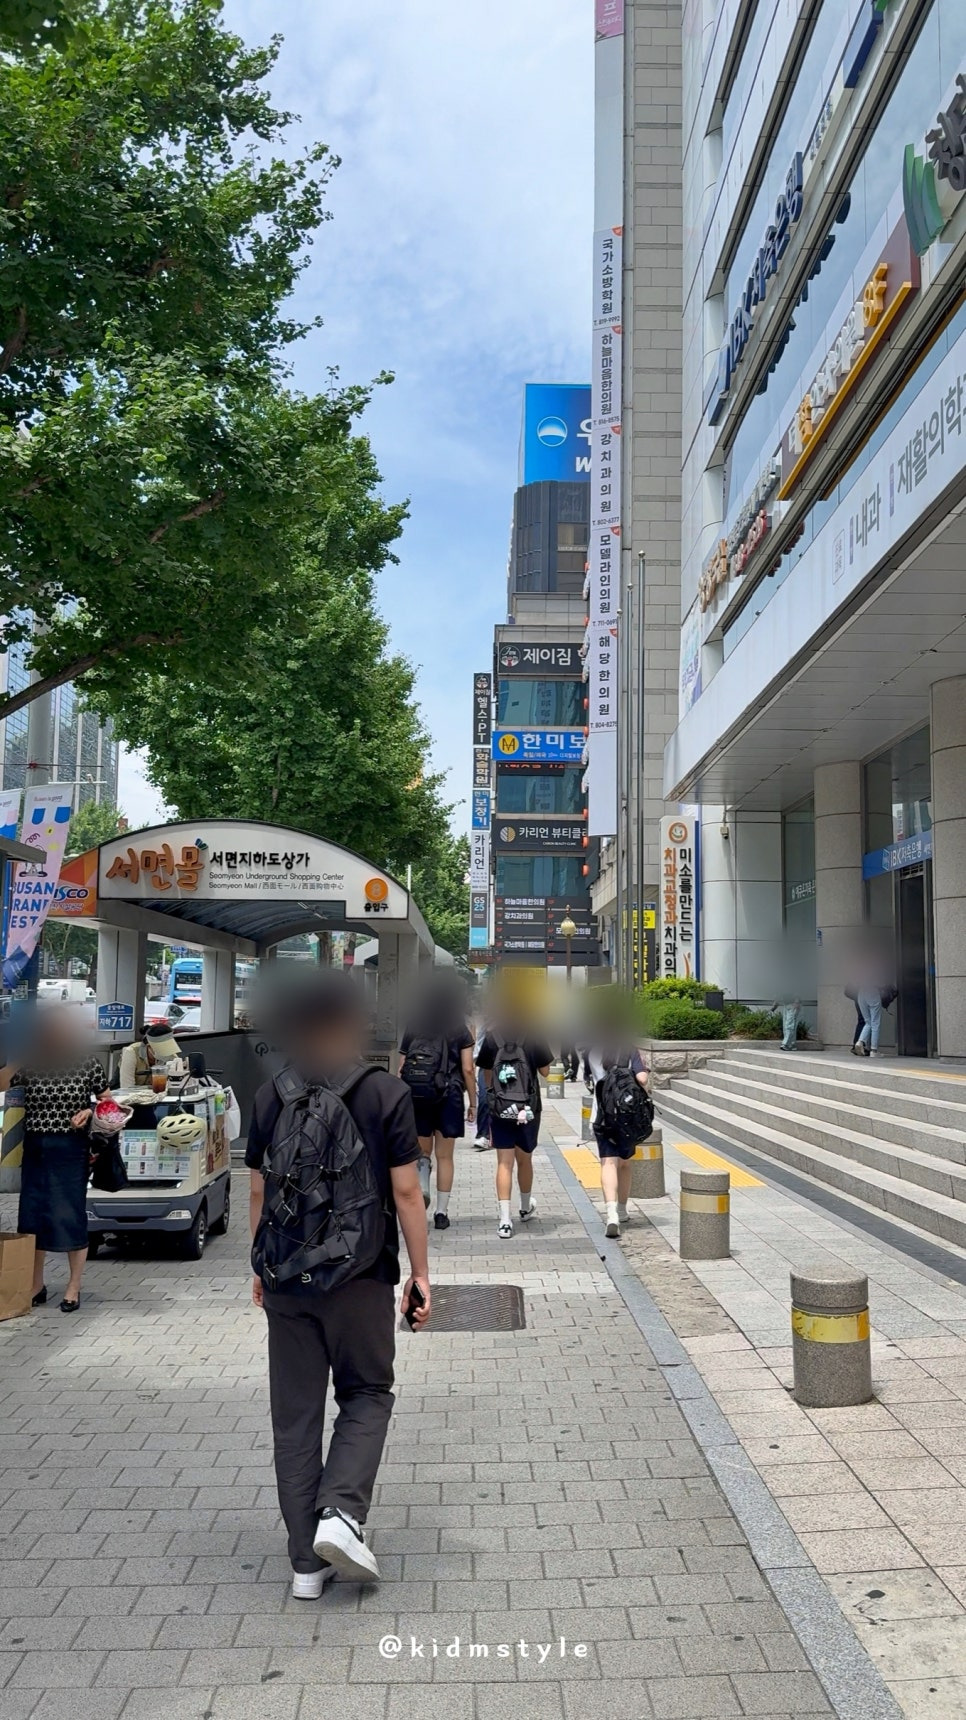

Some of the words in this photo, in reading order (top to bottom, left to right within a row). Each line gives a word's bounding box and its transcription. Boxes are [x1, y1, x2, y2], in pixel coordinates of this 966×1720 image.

[601, 238, 613, 314] 국가소방학원
[729, 151, 803, 373] IBK저축은행
[600, 333, 612, 415] 하늘마음한의원
[600, 433, 612, 513] 강치과의원
[855, 482, 881, 548] 내과
[897, 375, 966, 495] 재활의학
[599, 534, 611, 614] 모델라인의원
[523, 648, 572, 666] 제이짐
[599, 635, 611, 716] 해당한의원
[474, 798, 488, 826] 보청기
[519, 826, 549, 839] 카리언
[210, 851, 311, 870] 서면지하도상가
[474, 834, 486, 870] 카리언
[890, 840, 922, 868] IBK저축은행
[105, 842, 205, 892] 서면몰
[209, 872, 244, 880] Seomyeon
[245, 873, 287, 881] Underground
[289, 873, 321, 881] Shopping
[208, 882, 243, 890] Seomyeon
[473, 896, 485, 904] GS
[679, 847, 693, 942] 미소를만드는
[13, 898, 49, 912] RAN
[364, 902, 389, 912] 출입구
[473, 904, 485, 912] 25
[555, 927, 591, 935] 모의원
